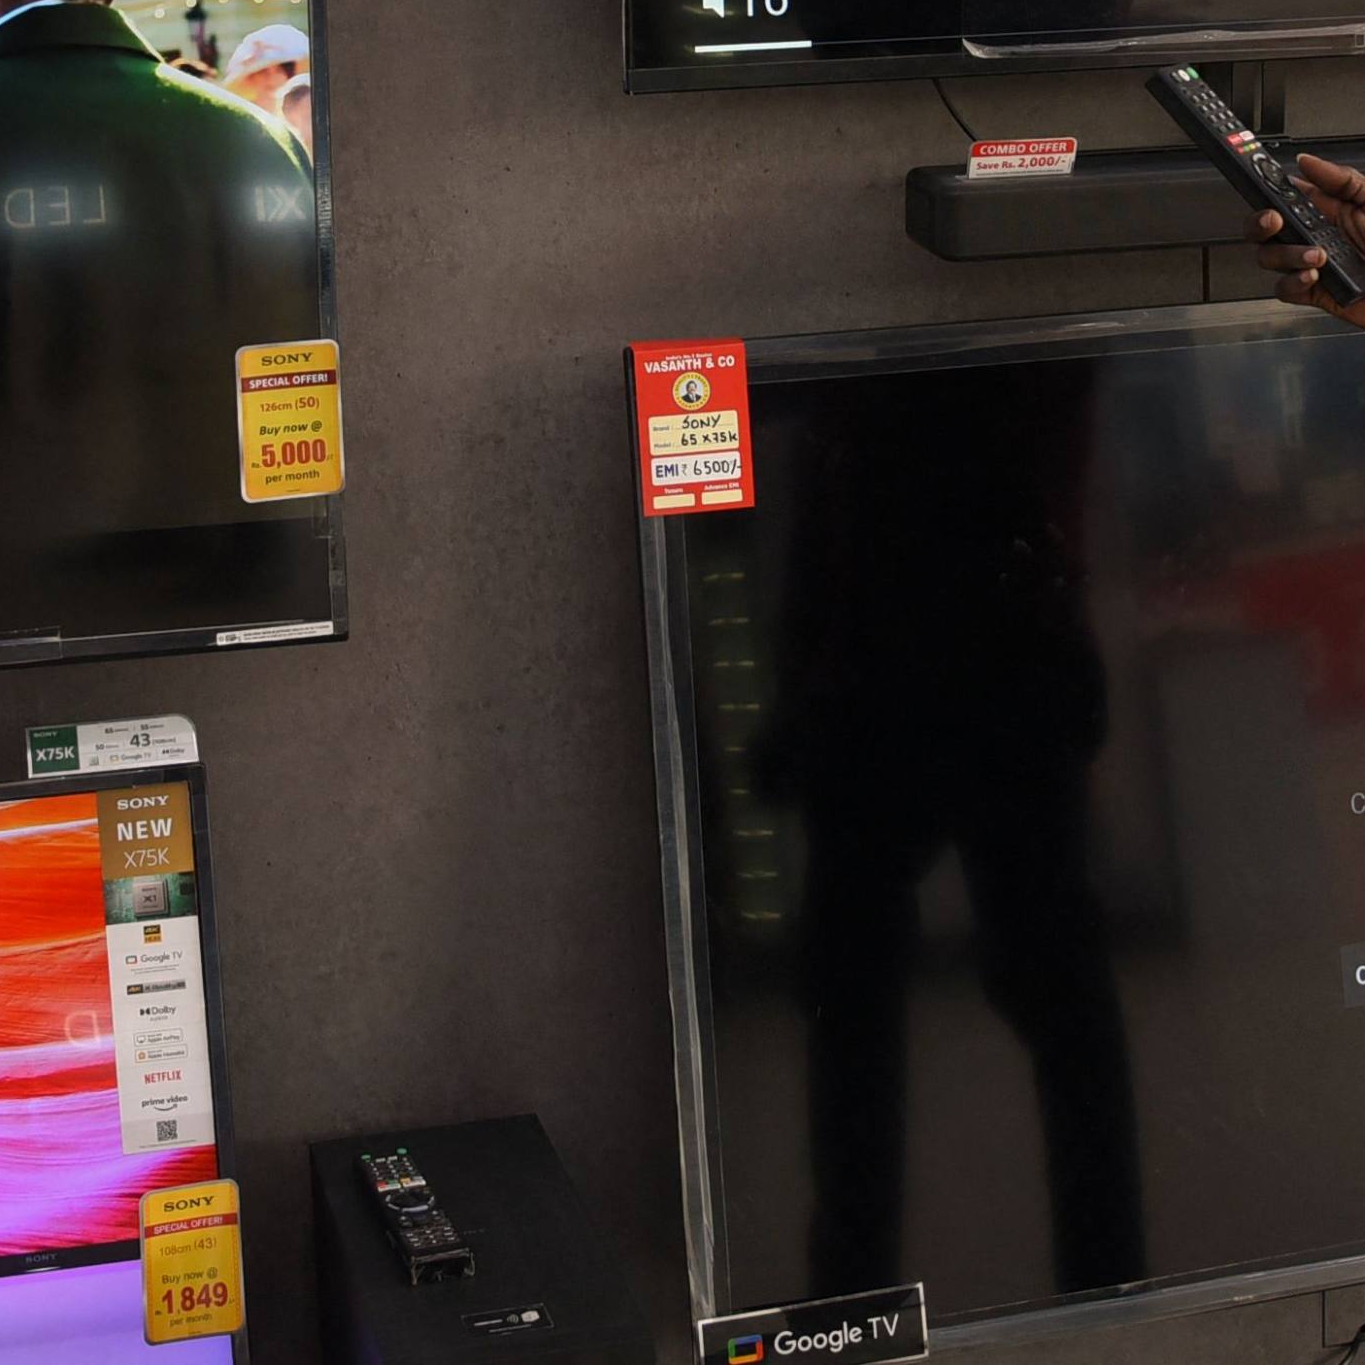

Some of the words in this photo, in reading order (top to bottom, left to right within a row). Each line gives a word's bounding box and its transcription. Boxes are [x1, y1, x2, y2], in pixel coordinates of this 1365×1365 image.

[980, 144, 1025, 154] COMBO
[1029, 142, 1067, 152] OFFER
[977, 161, 999, 170] Save
[1002, 161, 1015, 169] Rs.
[1018, 156, 1065, 169] 2,000/-
[261, 352, 313, 366] SONY
[644, 358, 702, 373] VASANTH
[705, 357, 715, 369] &
[717, 355, 735, 367] CO
[249, 376, 290, 389] SPECIAL
[293, 374, 328, 384] OFFER!
[260, 403, 292, 413] 126cm
[295, 396, 319, 411] (50)
[260, 426, 281, 436] Buy
[283, 424, 308, 433] now
[311, 420, 322, 432] @
[682, 414, 721, 429] SONY
[261, 439, 326, 469] 5,000
[265, 476, 282, 484] per
[285, 470, 320, 481] month
[655, 464, 679, 478] EMI
[36, 746, 75, 762] X75K
[117, 795, 169, 810] SONY
[117, 818, 172, 842] NEW
[124, 847, 170, 869] X75K
[140, 953, 170, 963] Google
[171, 952, 183, 960] TV
[152, 1006, 177, 1017] Dolby
[145, 1070, 182, 1084] NETFLIX
[141, 1098, 164, 1107] prime
[167, 1095, 188, 1104] video
[164, 1196, 214, 1212] SONY
[154, 1221, 189, 1235] SPECIAL
[191, 1217, 223, 1228] OFFER!
[194, 1237, 216, 1251] (43)
[162, 1274, 181, 1284] Buy
[183, 1270, 203, 1280] now
[170, 1316, 184, 1327] per
[186, 1313, 212, 1324] month
[773, 1321, 863, 1355] Google
[868, 1313, 899, 1339] TV
